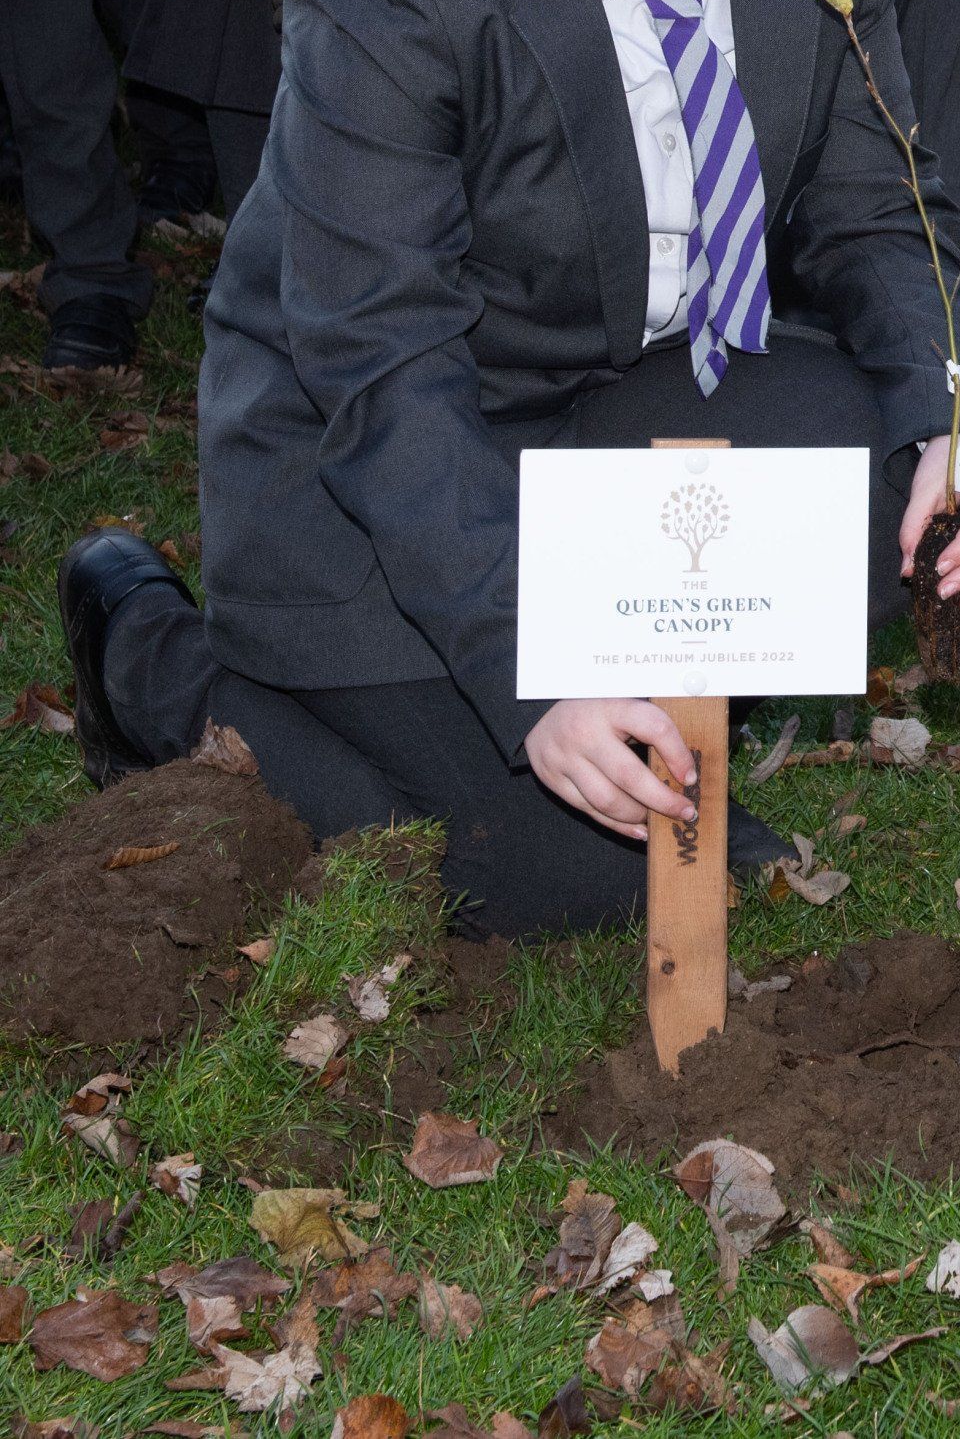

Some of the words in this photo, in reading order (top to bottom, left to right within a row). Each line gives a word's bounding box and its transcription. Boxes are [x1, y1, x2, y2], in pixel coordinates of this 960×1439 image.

[681, 580, 709, 590] THE
[616, 598, 701, 616] QUEEN'S
[706, 596, 772, 612] GREEN
[653, 617, 735, 633] CANOPY
[592, 654, 620, 664] THE
[625, 653, 695, 664] PLATINUM
[699, 652, 757, 663] JUBILEE
[761, 651, 795, 662] 2022
